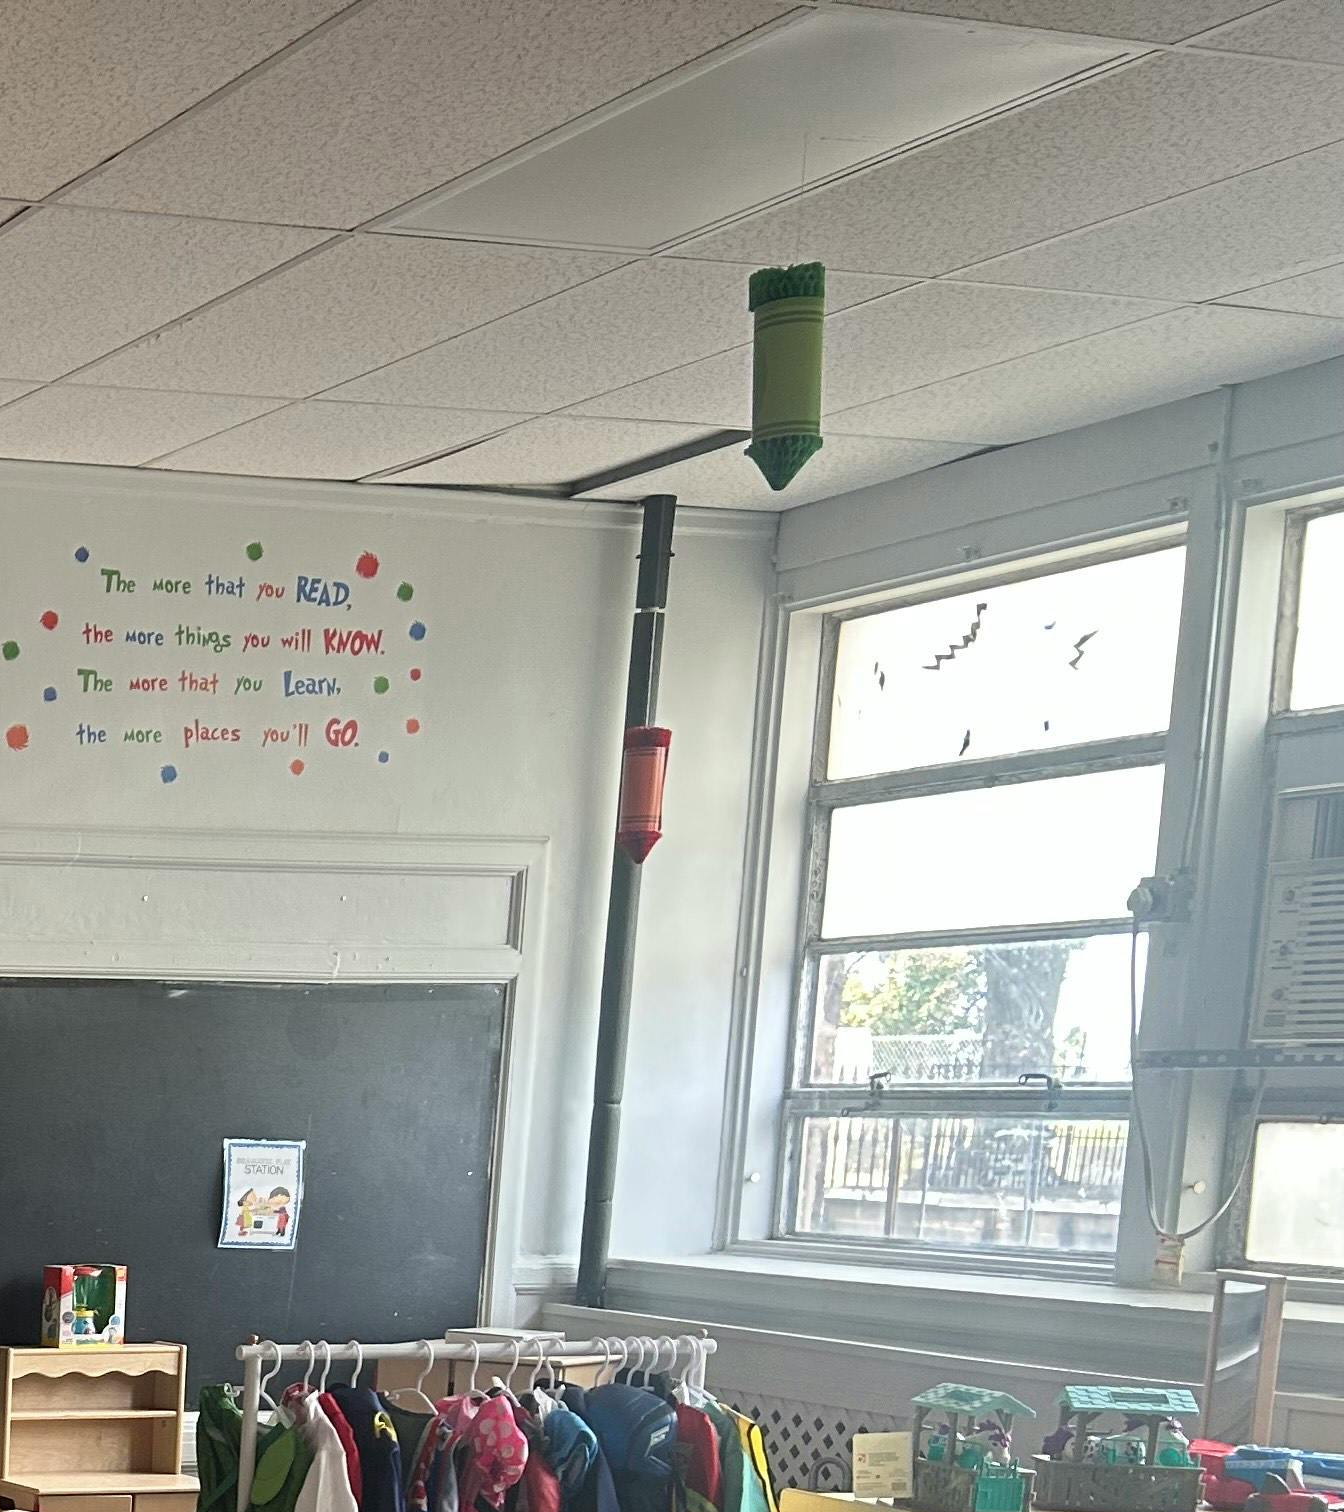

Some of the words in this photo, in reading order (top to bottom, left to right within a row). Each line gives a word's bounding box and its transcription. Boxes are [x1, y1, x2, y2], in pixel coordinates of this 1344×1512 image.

[100, 568, 137, 593] The
[204, 573, 246, 598] that
[255, 582, 286, 601] you
[295, 575, 352, 611] READ,
[81, 622, 114, 645] the
[174, 624, 232, 654] things
[242, 632, 271, 653] you
[280, 628, 312, 654] will
[322, 628, 386, 656] KNOW.
[76, 668, 113, 693] The
[177, 670, 219, 694] that
[233, 676, 263, 695] you
[75, 722, 107, 745] the
[183, 719, 241, 748] places
[262, 723, 309, 747] you'll
[324, 718, 360, 748] GO.
[244, 1164, 285, 1175] STATION
